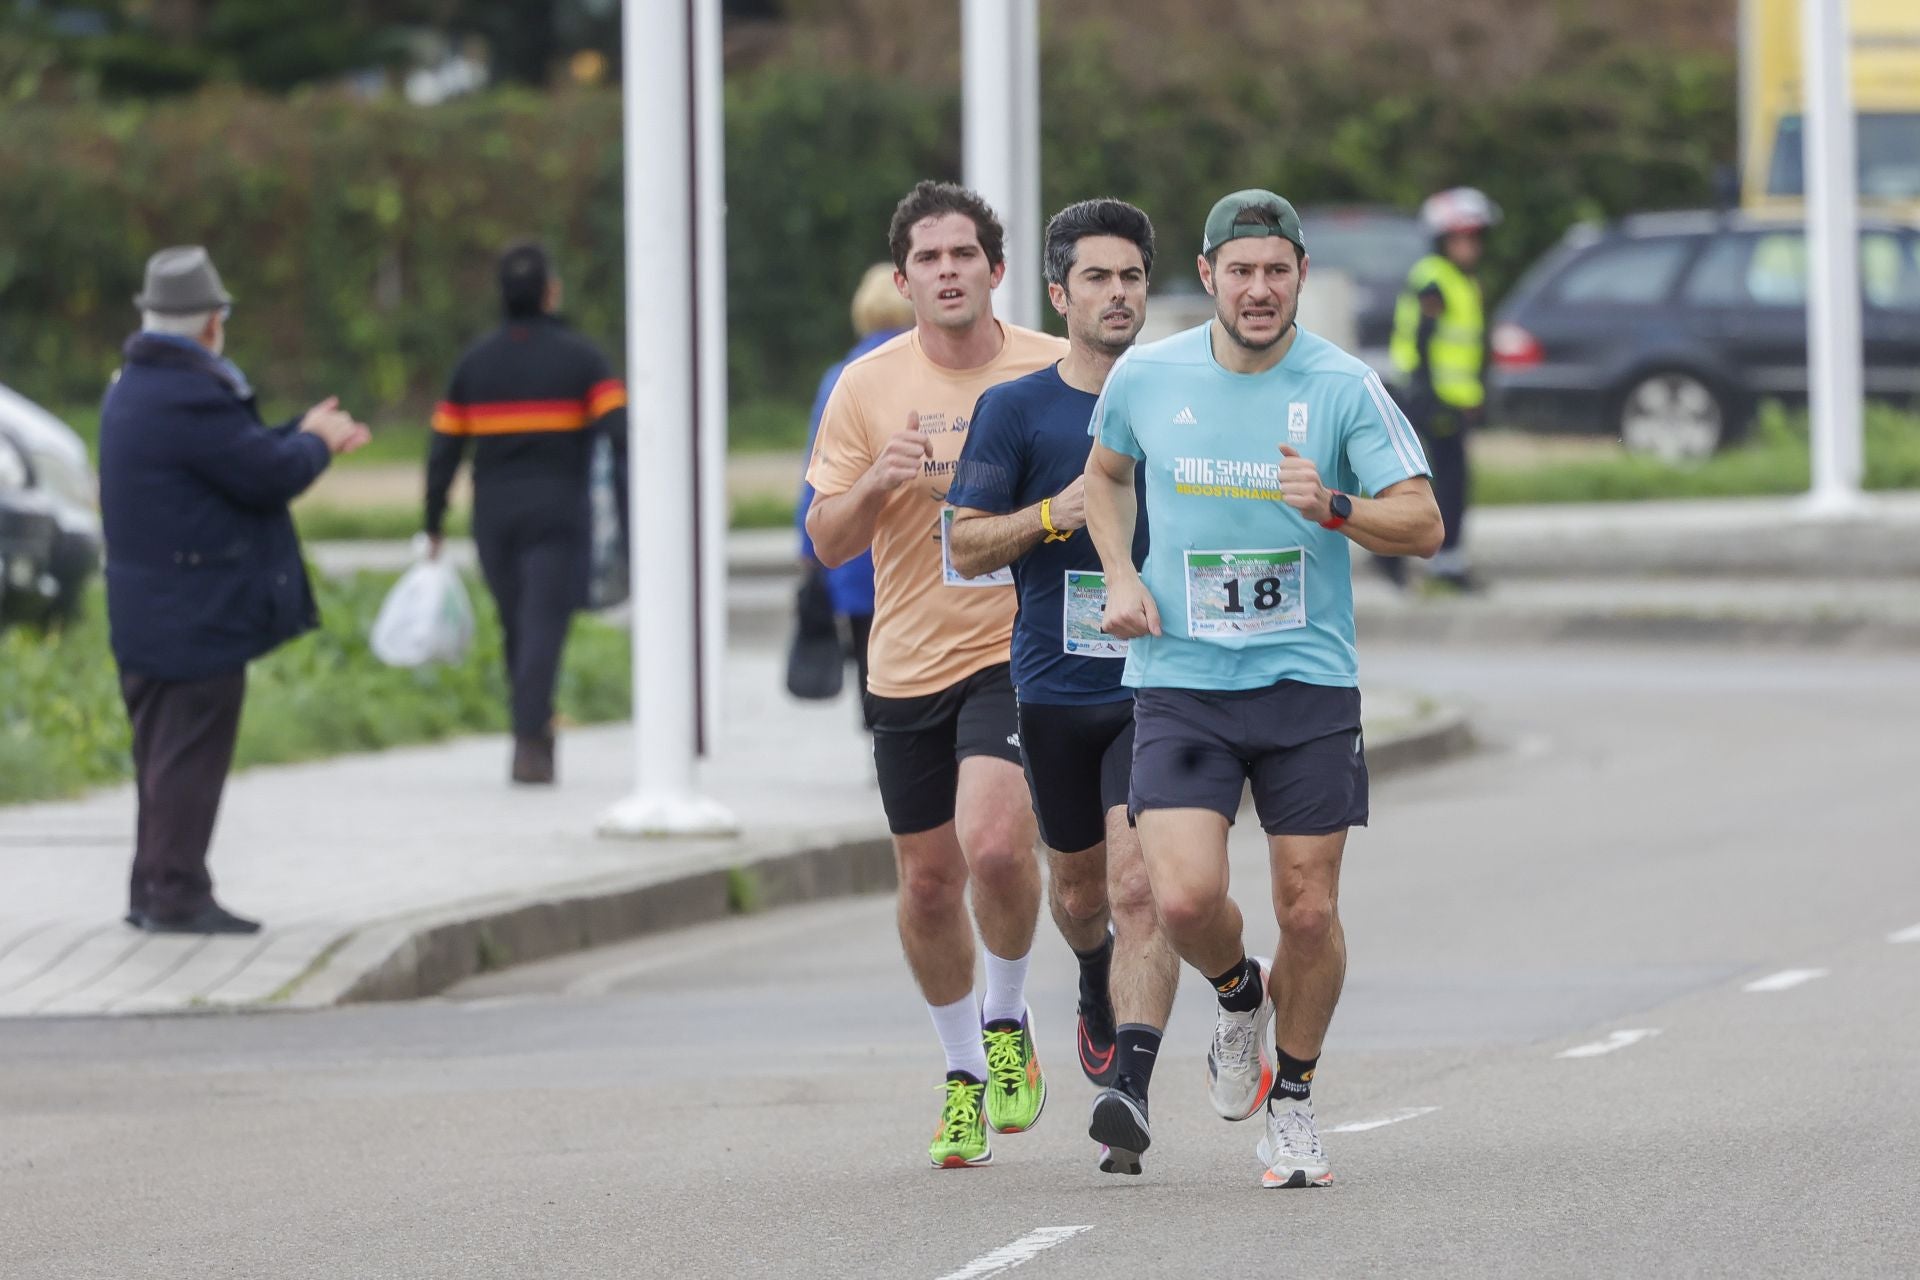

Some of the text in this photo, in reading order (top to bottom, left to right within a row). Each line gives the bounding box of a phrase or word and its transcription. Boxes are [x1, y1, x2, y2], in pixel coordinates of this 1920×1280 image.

[1174, 457, 1281, 484] 2016 SHANG
[1215, 475, 1245, 487] HALF
[1222, 577, 1282, 613] 18
